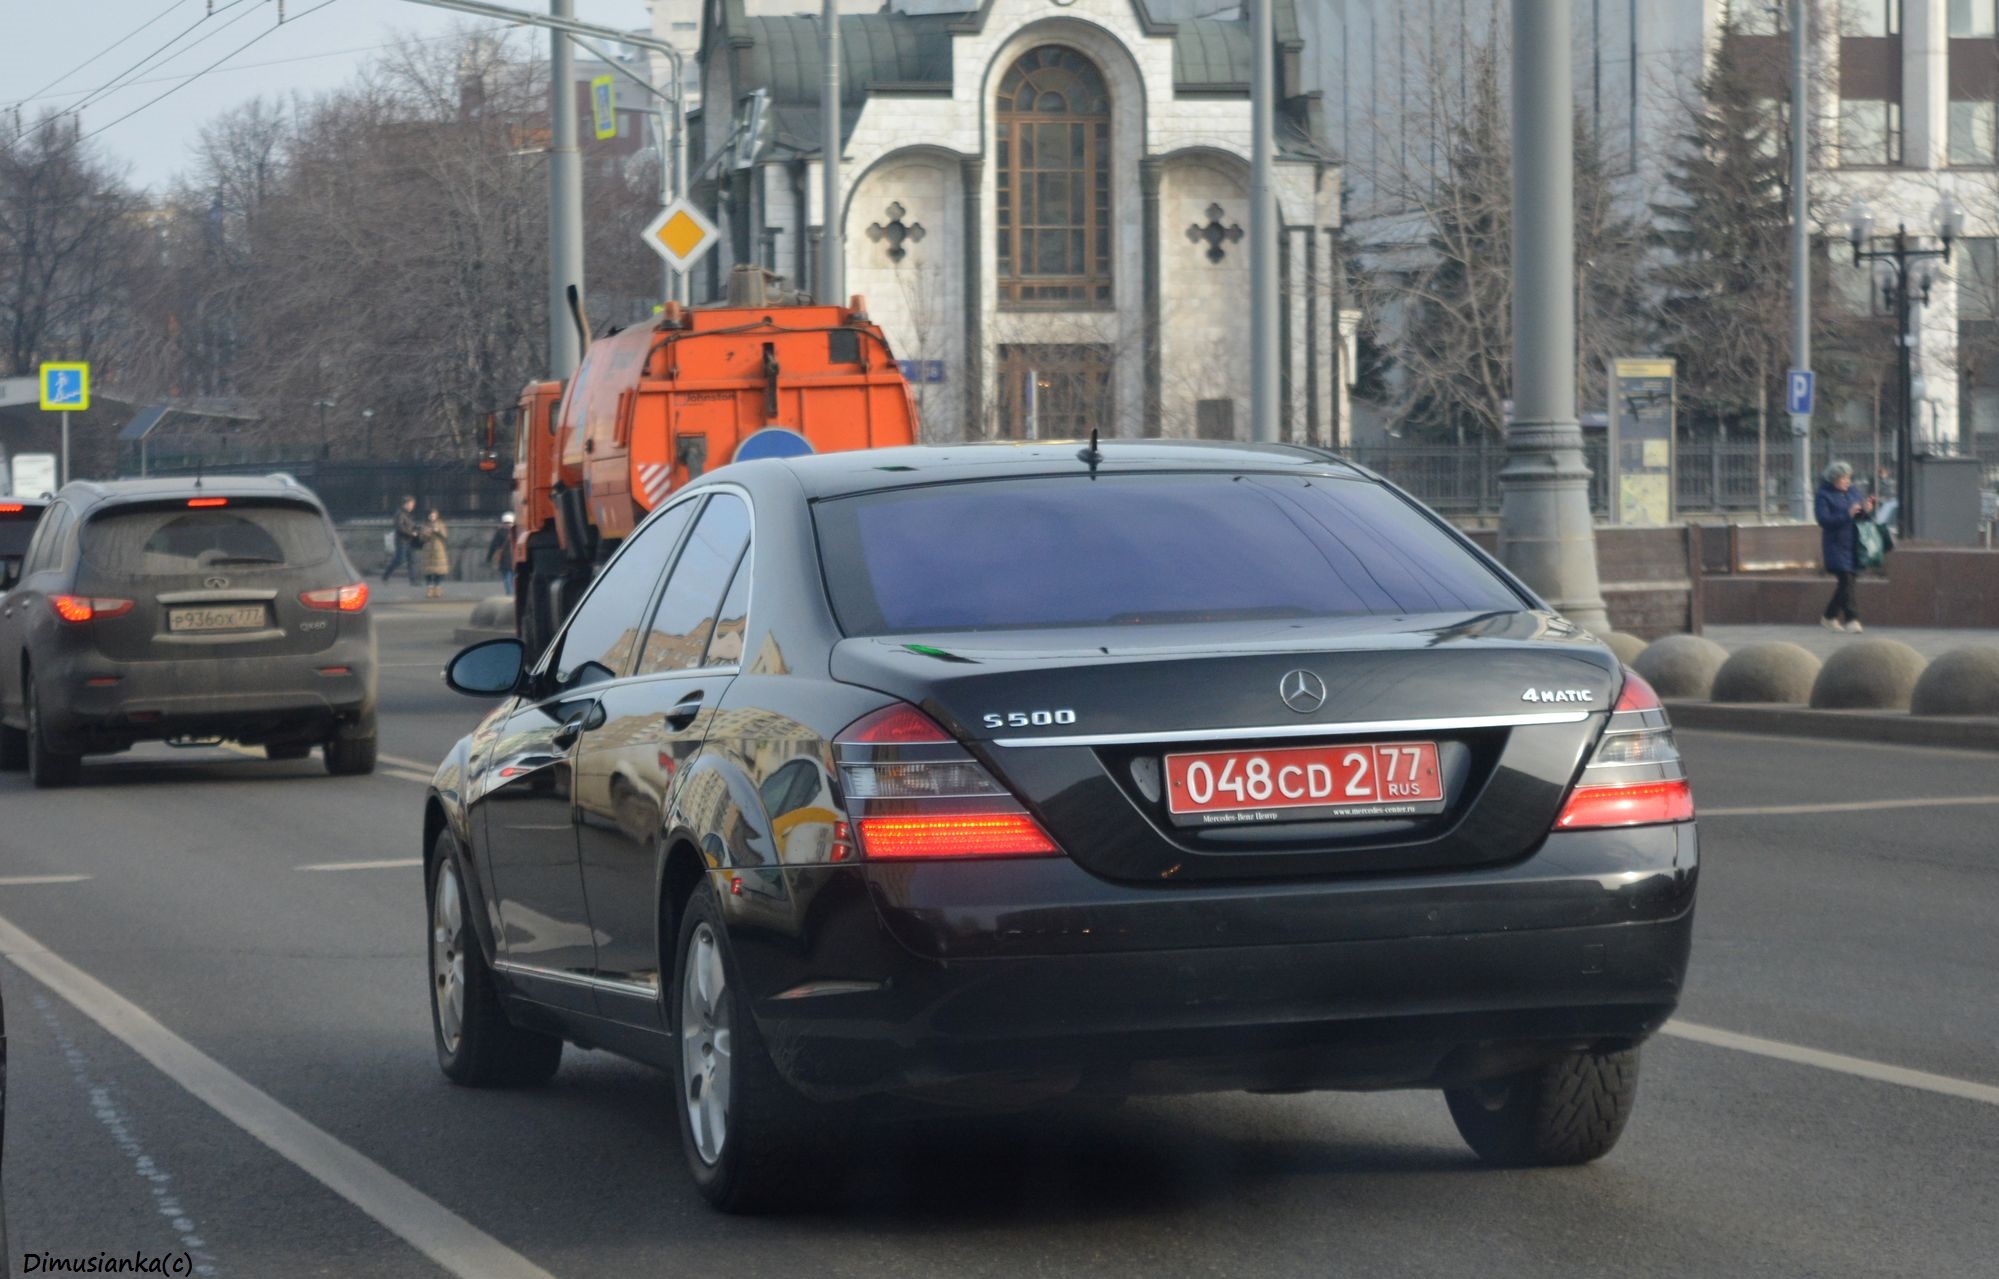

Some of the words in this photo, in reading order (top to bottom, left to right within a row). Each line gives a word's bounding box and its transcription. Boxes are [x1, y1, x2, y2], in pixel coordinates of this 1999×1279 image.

[1793, 375, 1808, 410] P
[1379, 748, 1421, 782] 77
[1388, 783, 1421, 796] RUS
